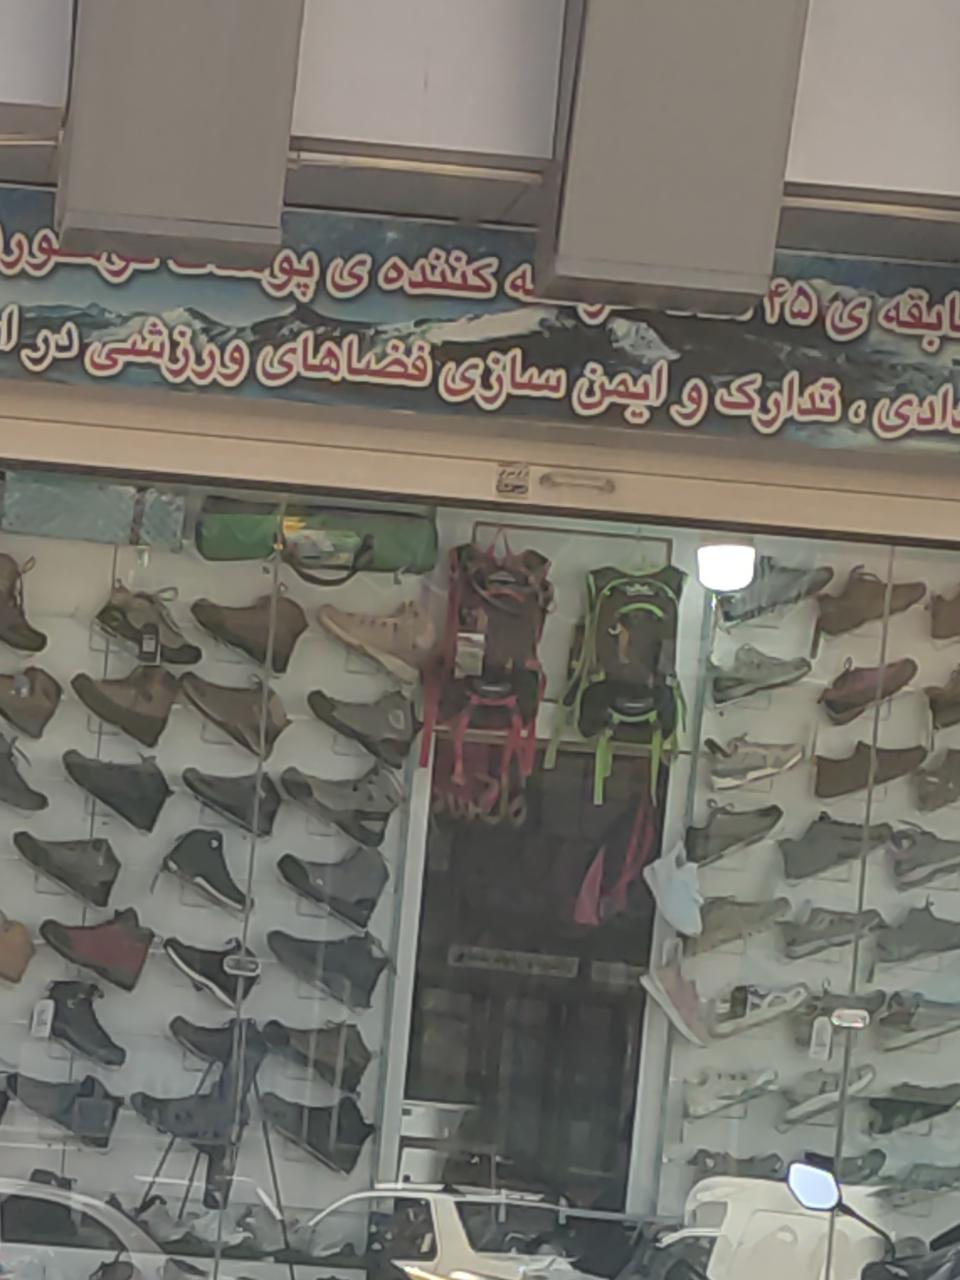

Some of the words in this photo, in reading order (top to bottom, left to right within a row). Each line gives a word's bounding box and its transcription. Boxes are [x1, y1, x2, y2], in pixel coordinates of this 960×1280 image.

[326, 253, 372, 299] ی
[378, 247, 499, 299] کننده
[764, 277, 818, 326] ۴۵
[825, 296, 872, 342] ی
[878, 287, 960, 353] ابقه
[20, 321, 79, 373] در
[84, 317, 249, 387] ورزشی
[256, 329, 433, 388] فضاهای
[439, 347, 566, 410] سازی
[573, 358, 667, 424] ایمن
[669, 377, 709, 427] و
[715, 371, 841, 434] تدارک
